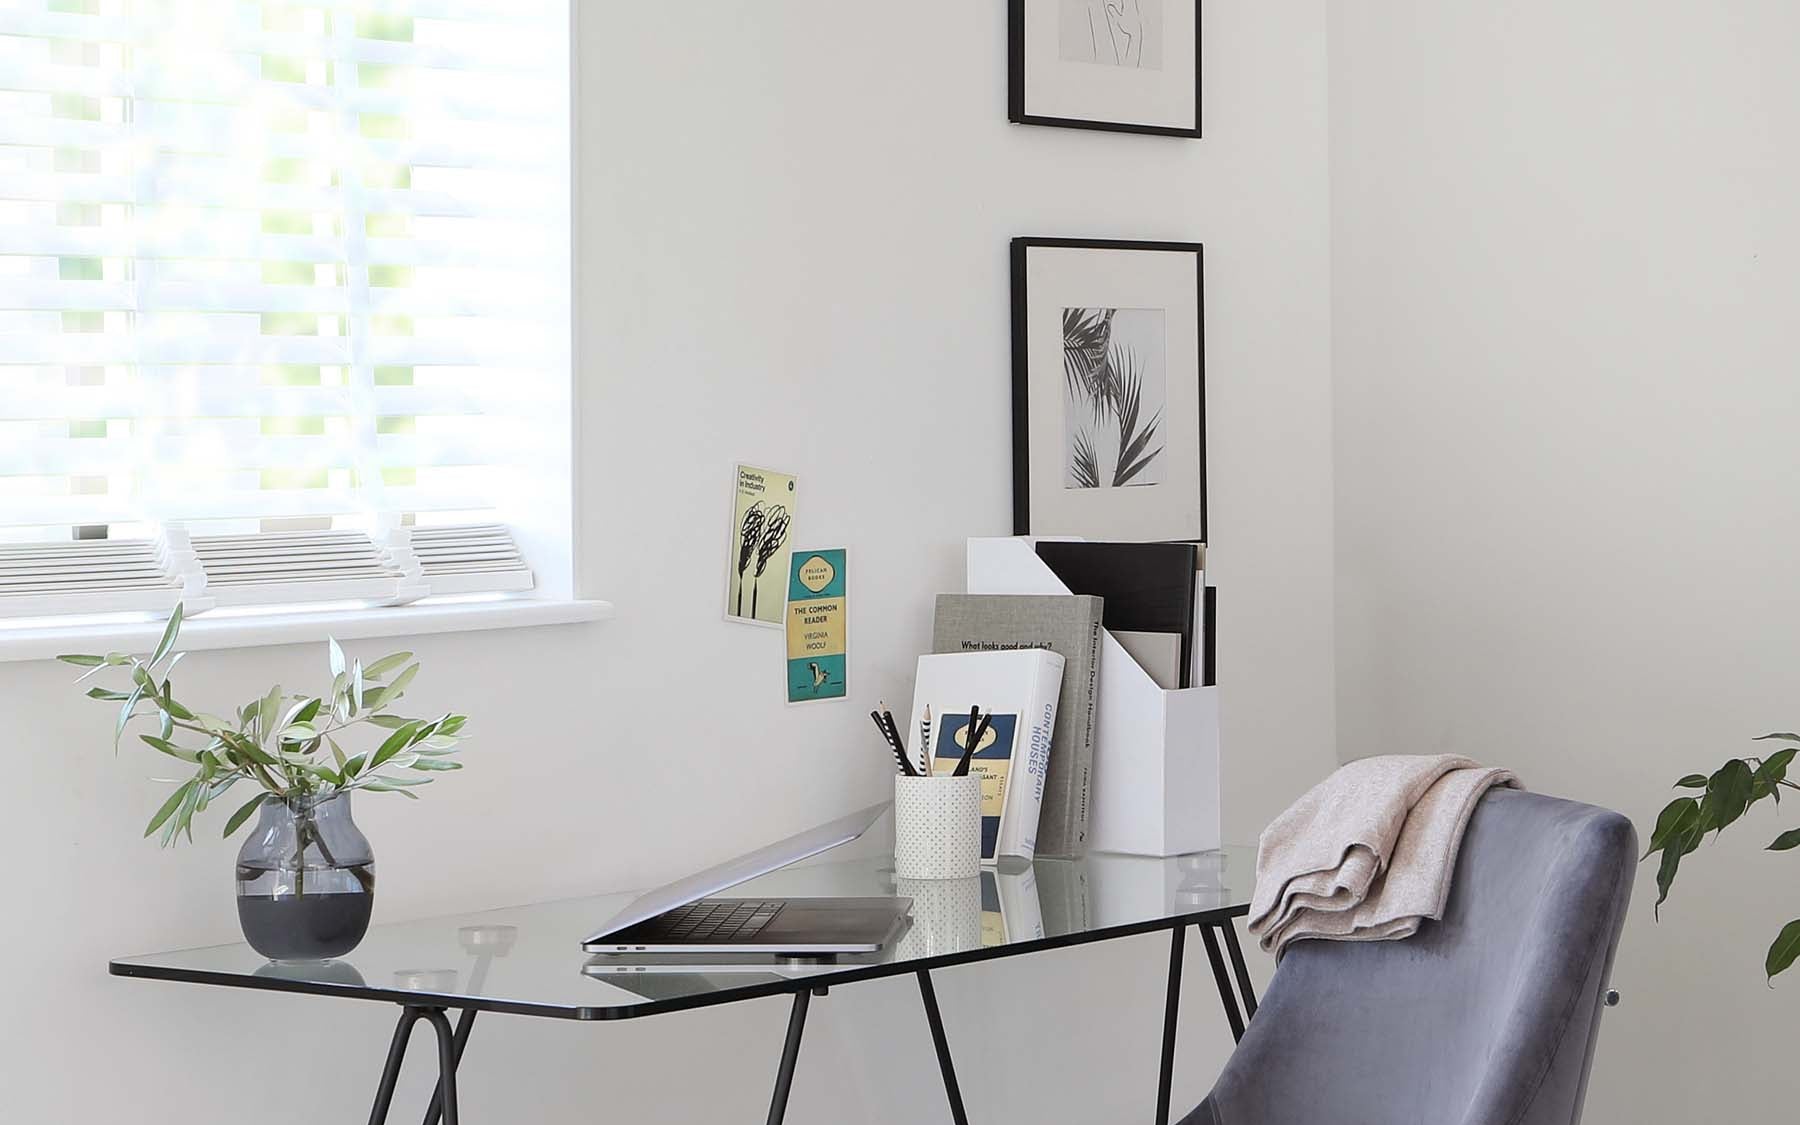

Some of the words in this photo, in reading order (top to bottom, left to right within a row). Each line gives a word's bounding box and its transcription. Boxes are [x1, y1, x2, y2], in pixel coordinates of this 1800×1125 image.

[740, 470, 765, 484] Creativity
[794, 606, 806, 615] THE
[808, 604, 838, 614] COMMON
[804, 615, 828, 625] READER
[961, 640, 981, 650] What
[981, 640, 999, 651] looks
[1028, 726, 1042, 775] HOUSES
[1033, 702, 1053, 802] CONTEMPORARY
